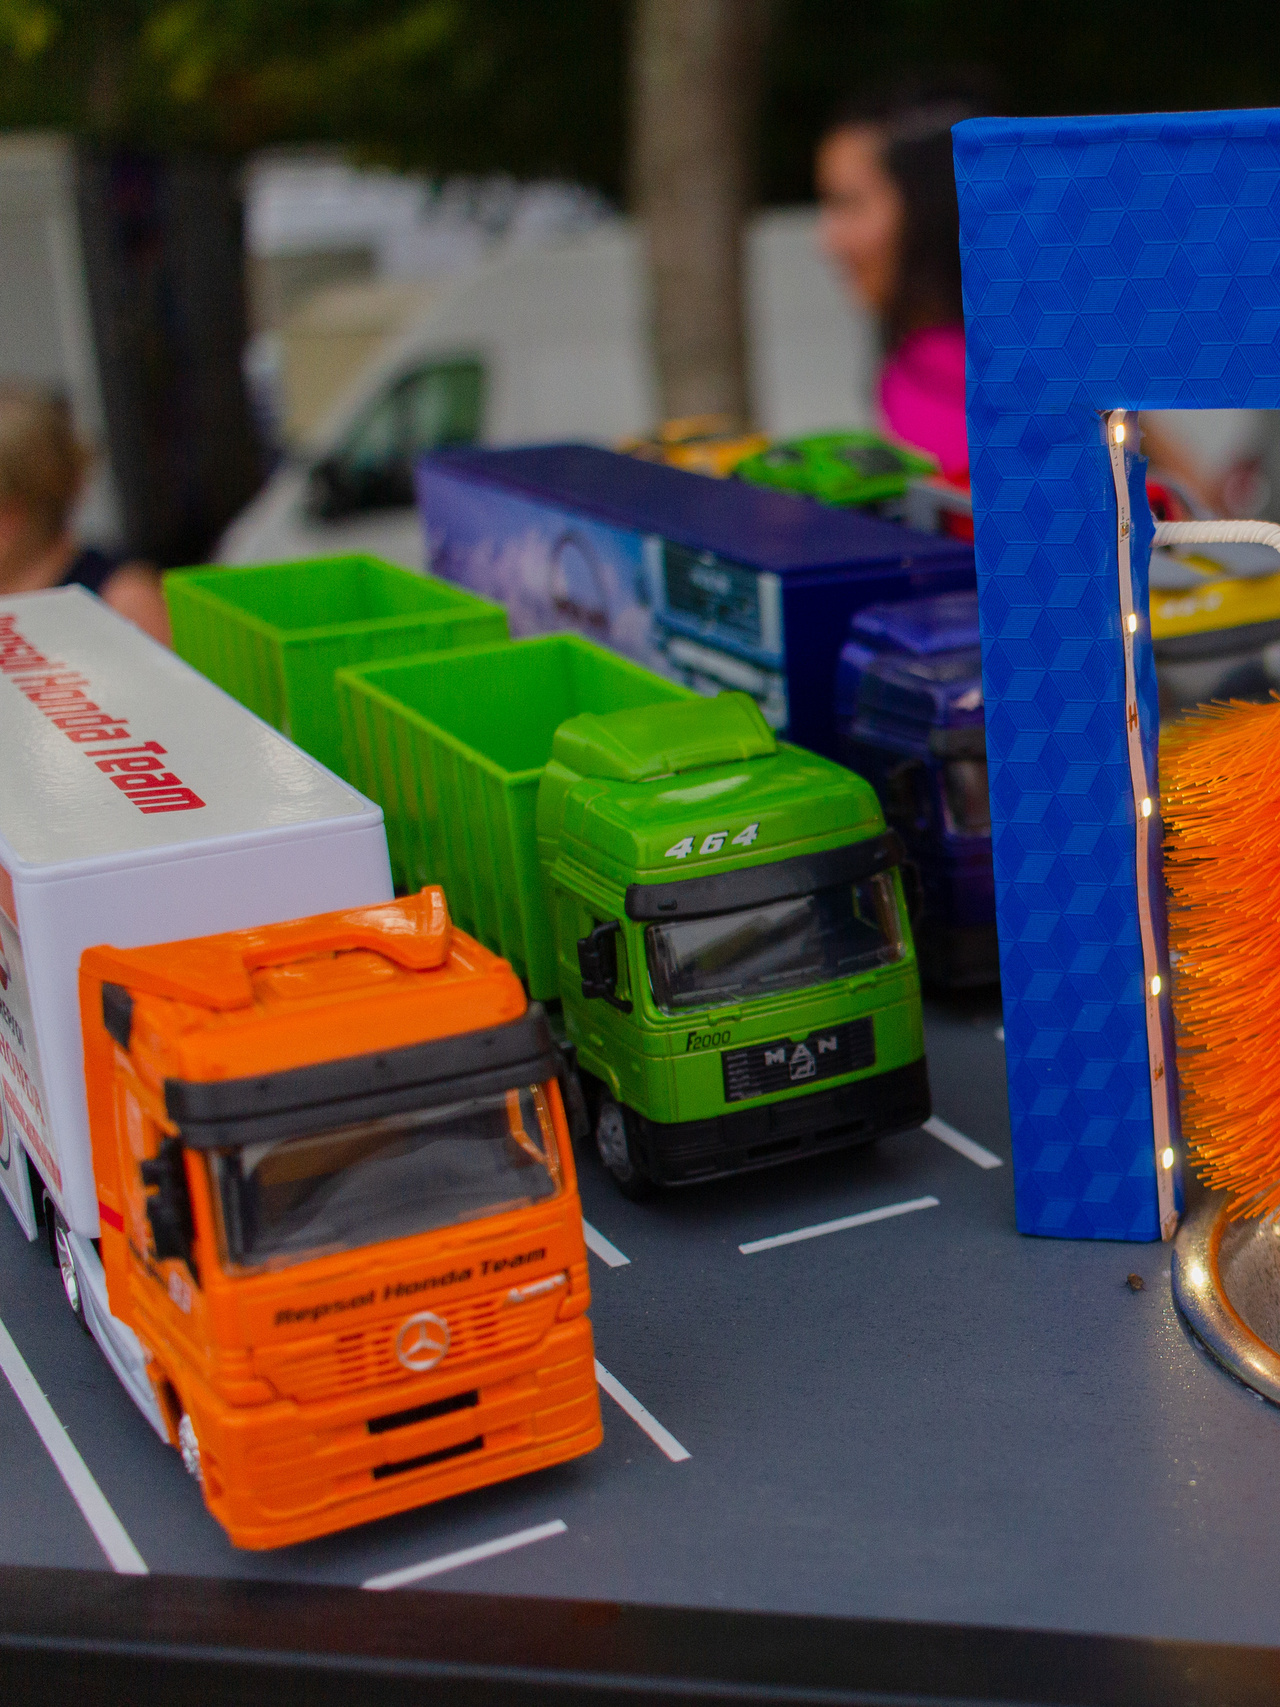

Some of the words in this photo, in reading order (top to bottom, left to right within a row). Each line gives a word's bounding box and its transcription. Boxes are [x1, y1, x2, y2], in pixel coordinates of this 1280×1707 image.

[12, 670, 132, 743] Honda
[84, 740, 207, 814] Team
[664, 821, 760, 859] 464
[686, 1030, 731, 1051] F2000
[764, 1036, 838, 1066] MAN
[274, 1289, 376, 1326] Repsol
[383, 1265, 474, 1301] Honda
[481, 1247, 547, 1277] Team
